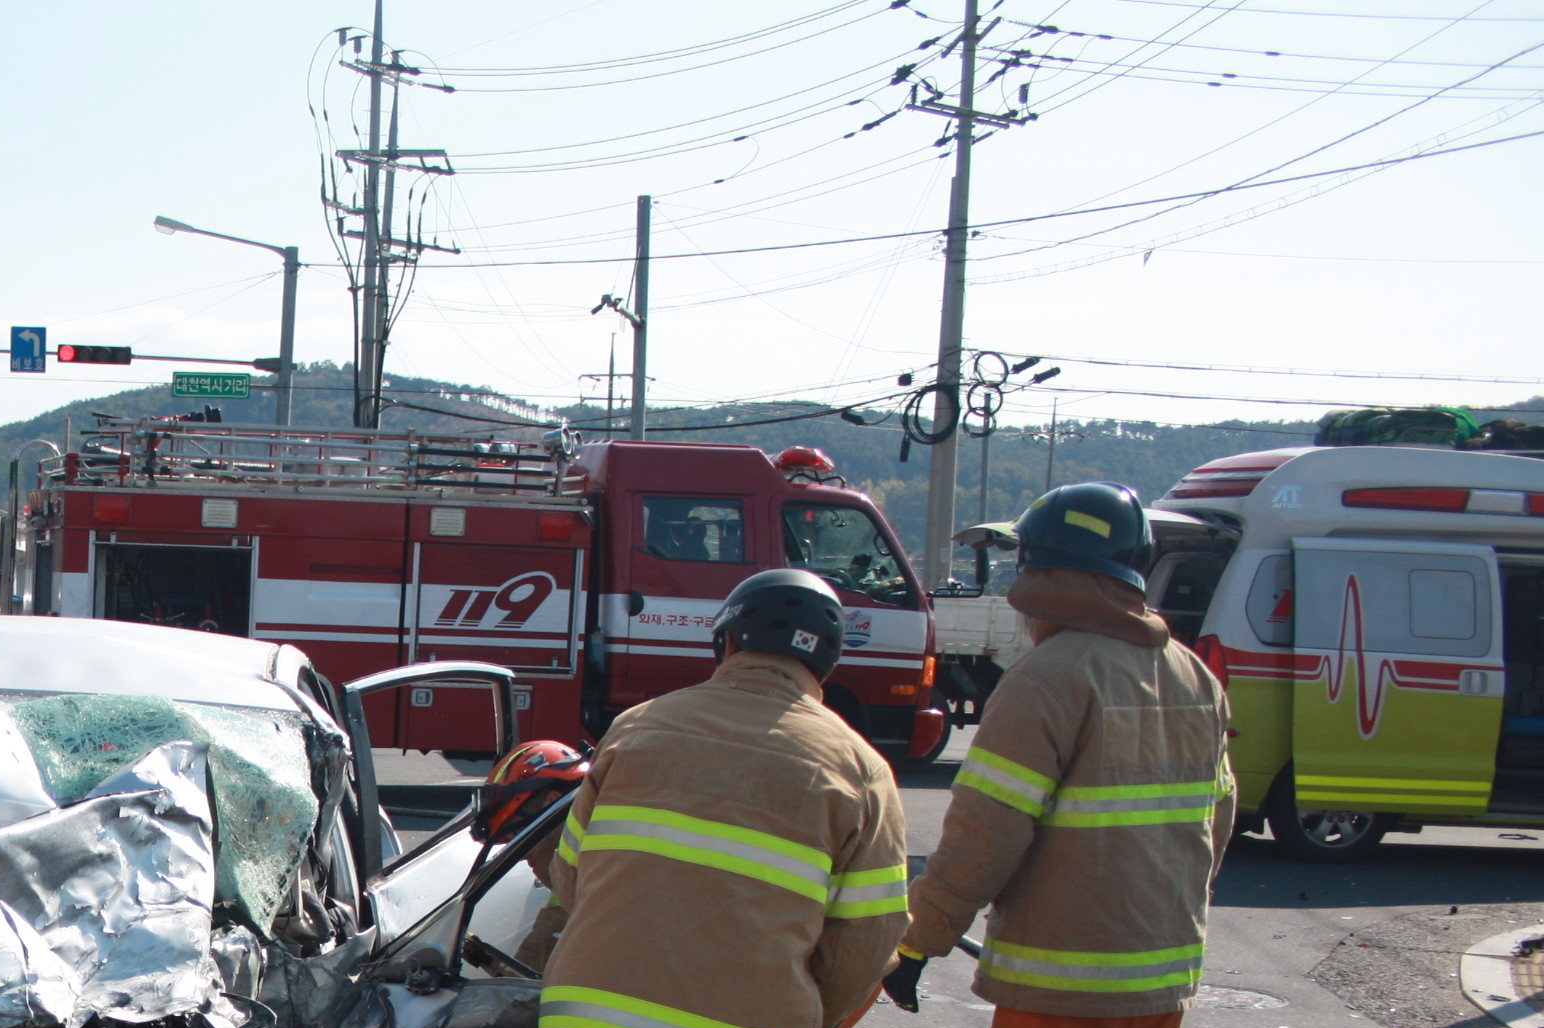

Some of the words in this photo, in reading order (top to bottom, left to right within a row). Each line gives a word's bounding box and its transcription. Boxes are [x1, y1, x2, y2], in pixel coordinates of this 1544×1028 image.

[11, 357, 44, 371] 비보호
[176, 377, 246, 394] 대천역사거리
[434, 575, 553, 629] 119
